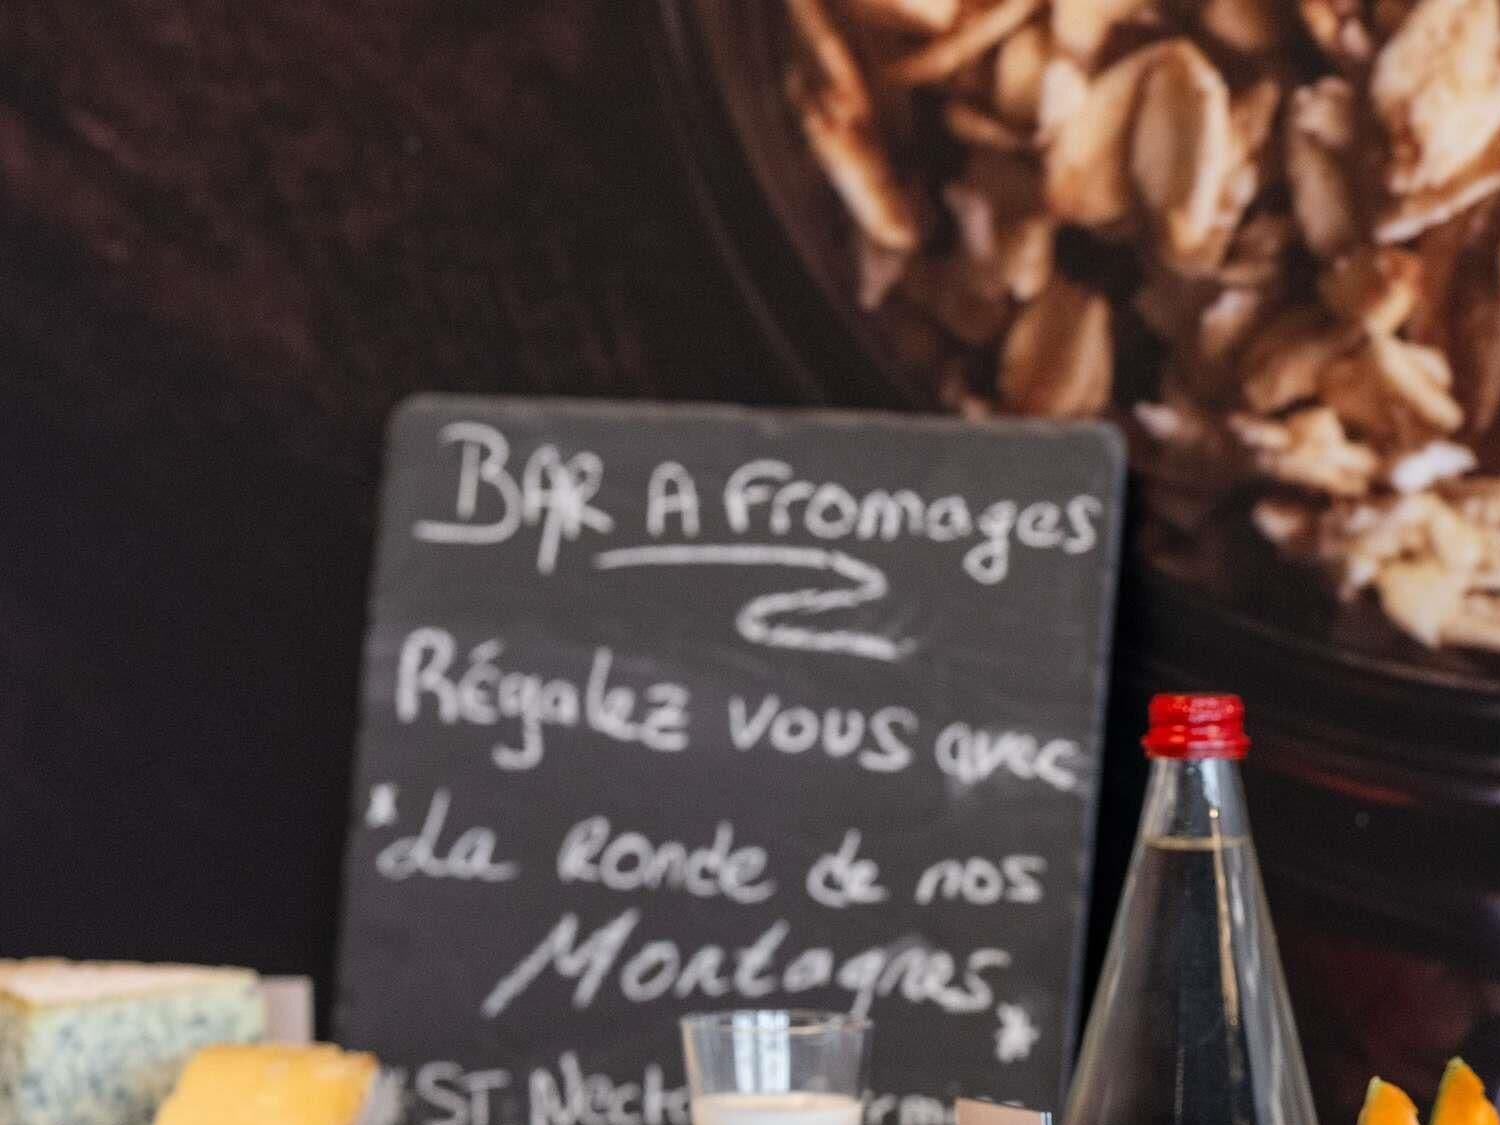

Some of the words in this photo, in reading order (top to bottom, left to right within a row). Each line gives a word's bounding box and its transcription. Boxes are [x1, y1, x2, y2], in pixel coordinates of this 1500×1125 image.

[647, 460, 699, 538] A
[806, 828, 890, 908] de
[914, 852, 1048, 904] nos
